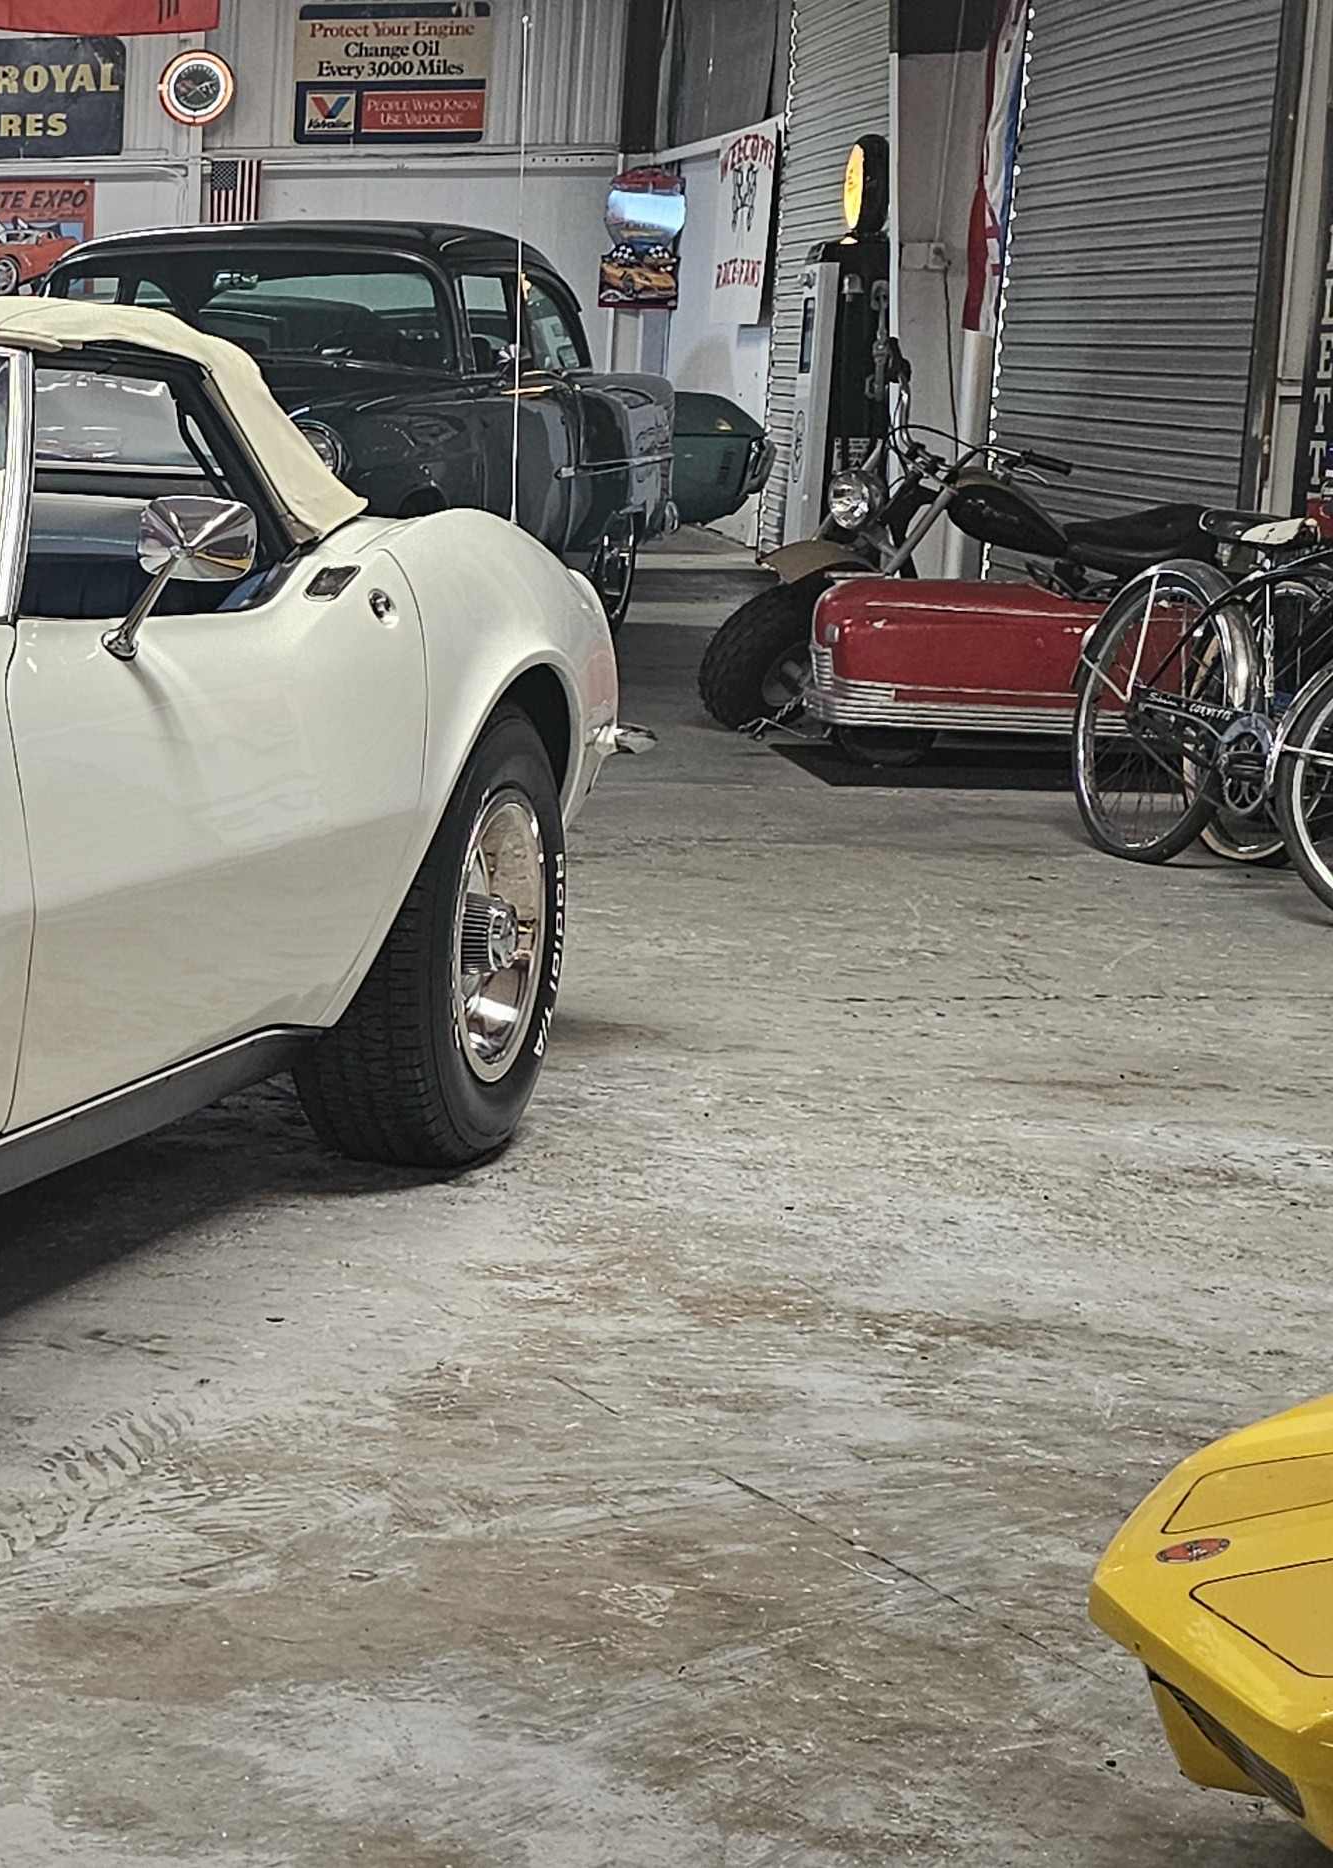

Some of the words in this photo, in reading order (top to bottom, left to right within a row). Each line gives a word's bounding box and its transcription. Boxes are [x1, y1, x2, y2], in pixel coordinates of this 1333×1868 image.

[310, 22, 369, 38] Protect
[372, 21, 410, 37] Your
[414, 20, 475, 39] Engine
[344, 41, 409, 60] Change
[412, 40, 440, 56] Oil
[317, 61, 365, 79] Every
[367, 61, 414, 78] 3,000
[417, 59, 464, 75] Miles
[367, 99, 409, 112] PEOPLE
[413, 99, 441, 111] WHO
[443, 98, 479, 111] KNOW
[307, 119, 352, 129] Valvoline
[380, 114, 403, 126] USE
[405, 113, 463, 126] VALVOLINE
[720, 134, 775, 184] WELCOME
[30, 190, 88, 208] EXPO
